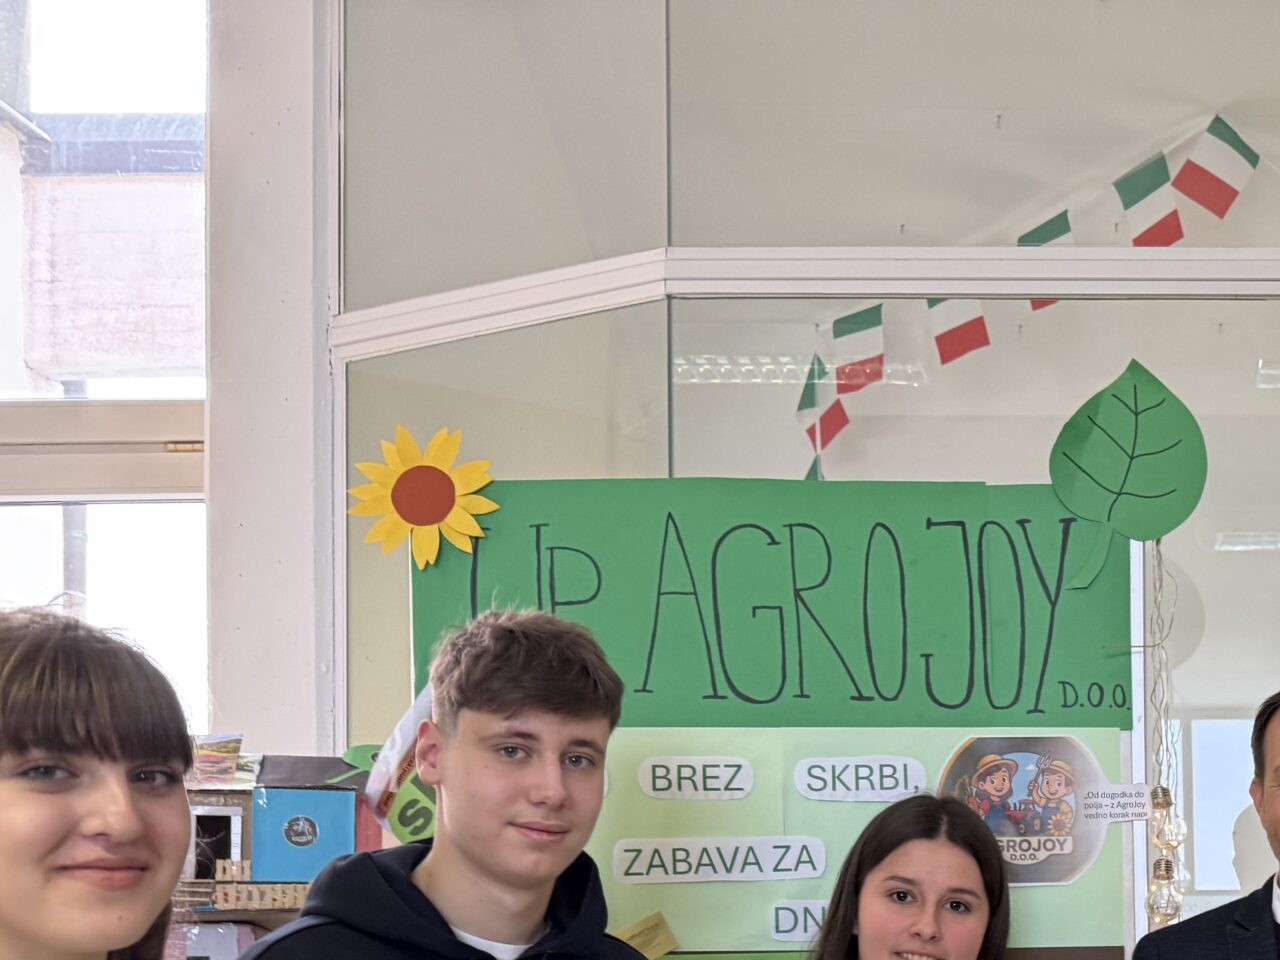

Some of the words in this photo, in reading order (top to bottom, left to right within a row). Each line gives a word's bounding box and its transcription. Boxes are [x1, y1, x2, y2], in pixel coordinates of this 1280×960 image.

[633, 511, 1077, 713] AGROJOY
[1058, 680, 1132, 711] D.O.O.
[651, 764, 745, 792] BREZ
[806, 763, 920, 793] SKRBI,
[1100, 791, 1133, 800] dogodka
[1084, 802, 1103, 810] polja
[1116, 801, 1146, 810] AgroJoy
[1109, 811, 1130, 819] korak
[998, 838, 1068, 852] GROJOY
[623, 845, 764, 876] ZABAVA
[772, 844, 817, 872] ZA
[1010, 853, 1039, 861] D.O.O.
